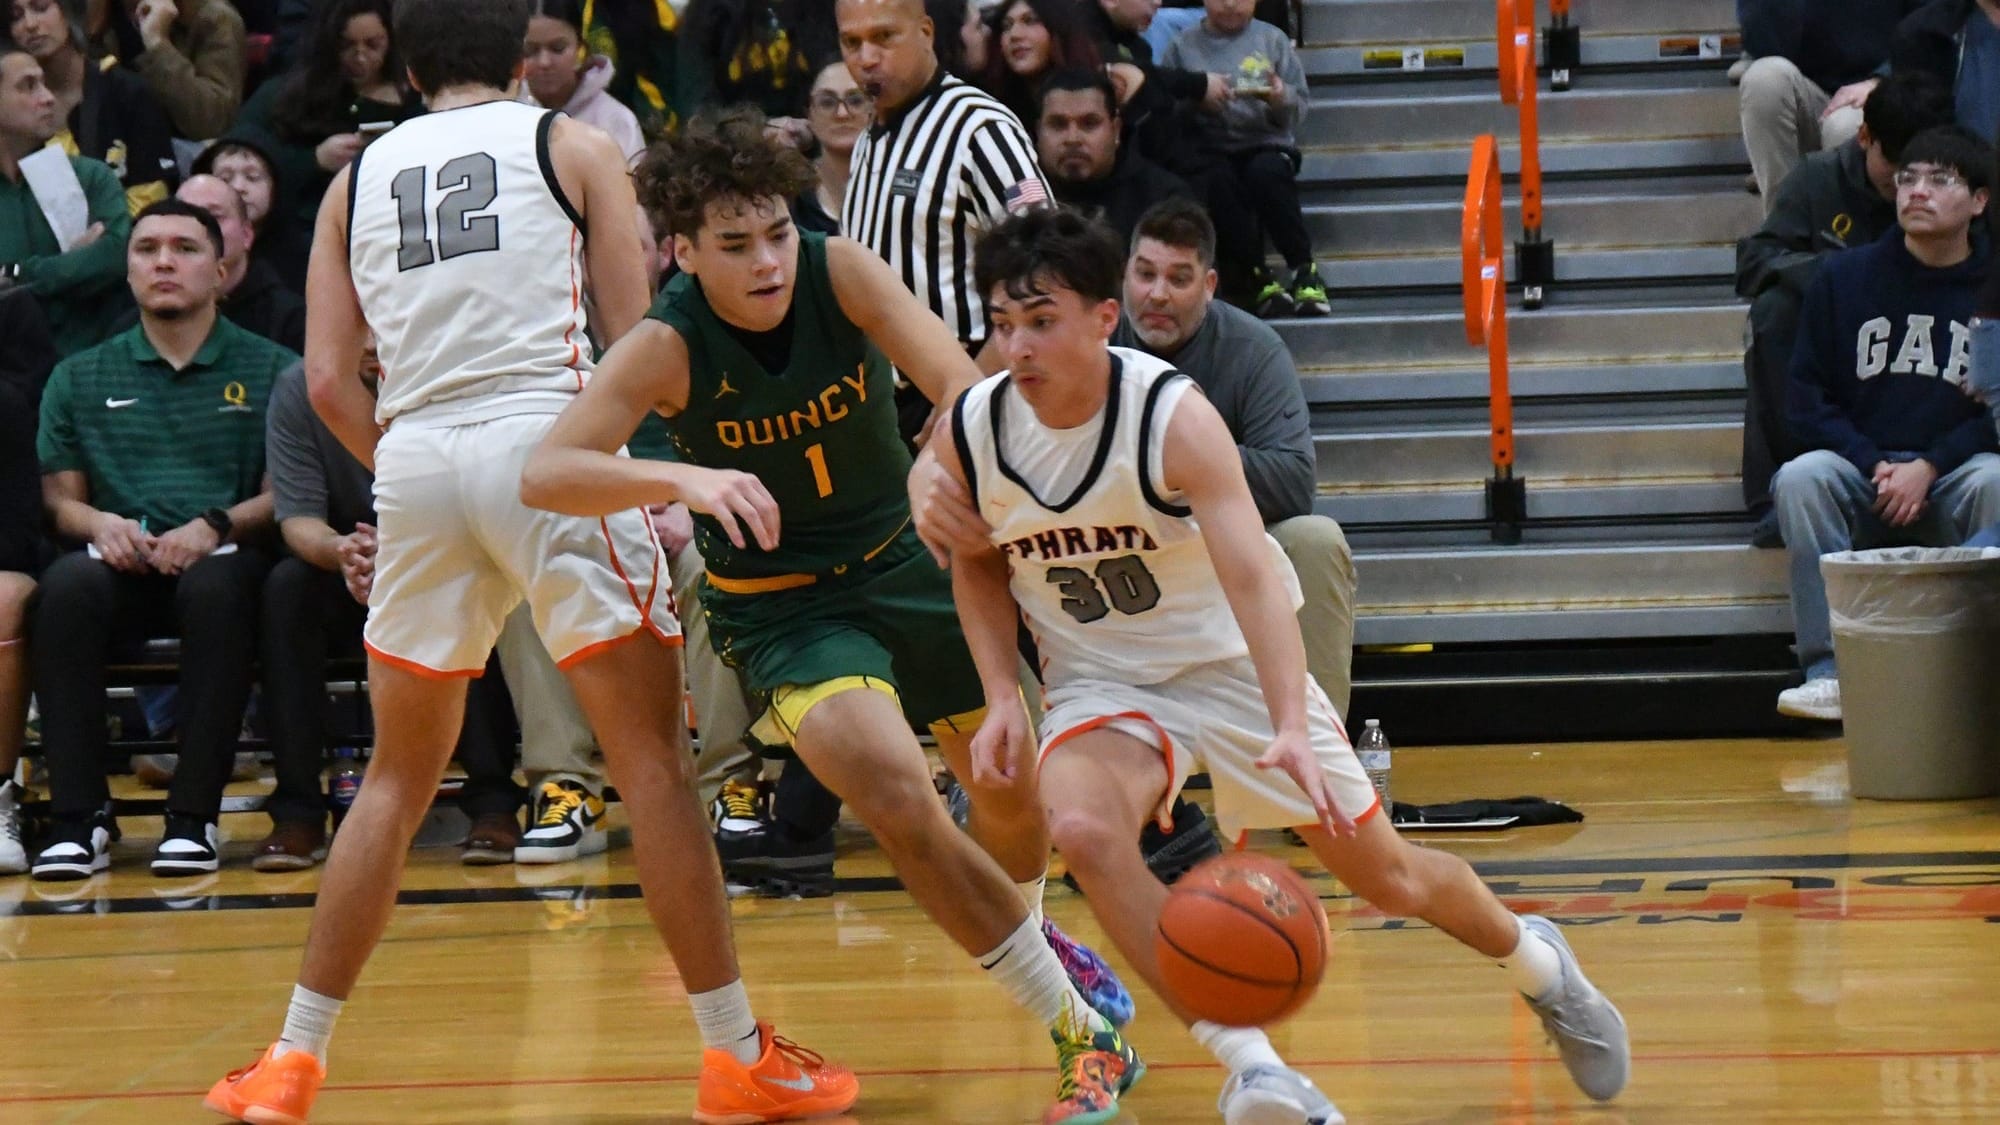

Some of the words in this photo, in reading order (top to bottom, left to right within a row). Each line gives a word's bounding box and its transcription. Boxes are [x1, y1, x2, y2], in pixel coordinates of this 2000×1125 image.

[391, 151, 499, 272] 12
[1831, 213, 1852, 239] Q
[223, 381, 247, 405] Q
[716, 362, 867, 449] QUINCY
[805, 443, 833, 498] 1
[1046, 554, 1161, 624] 30
